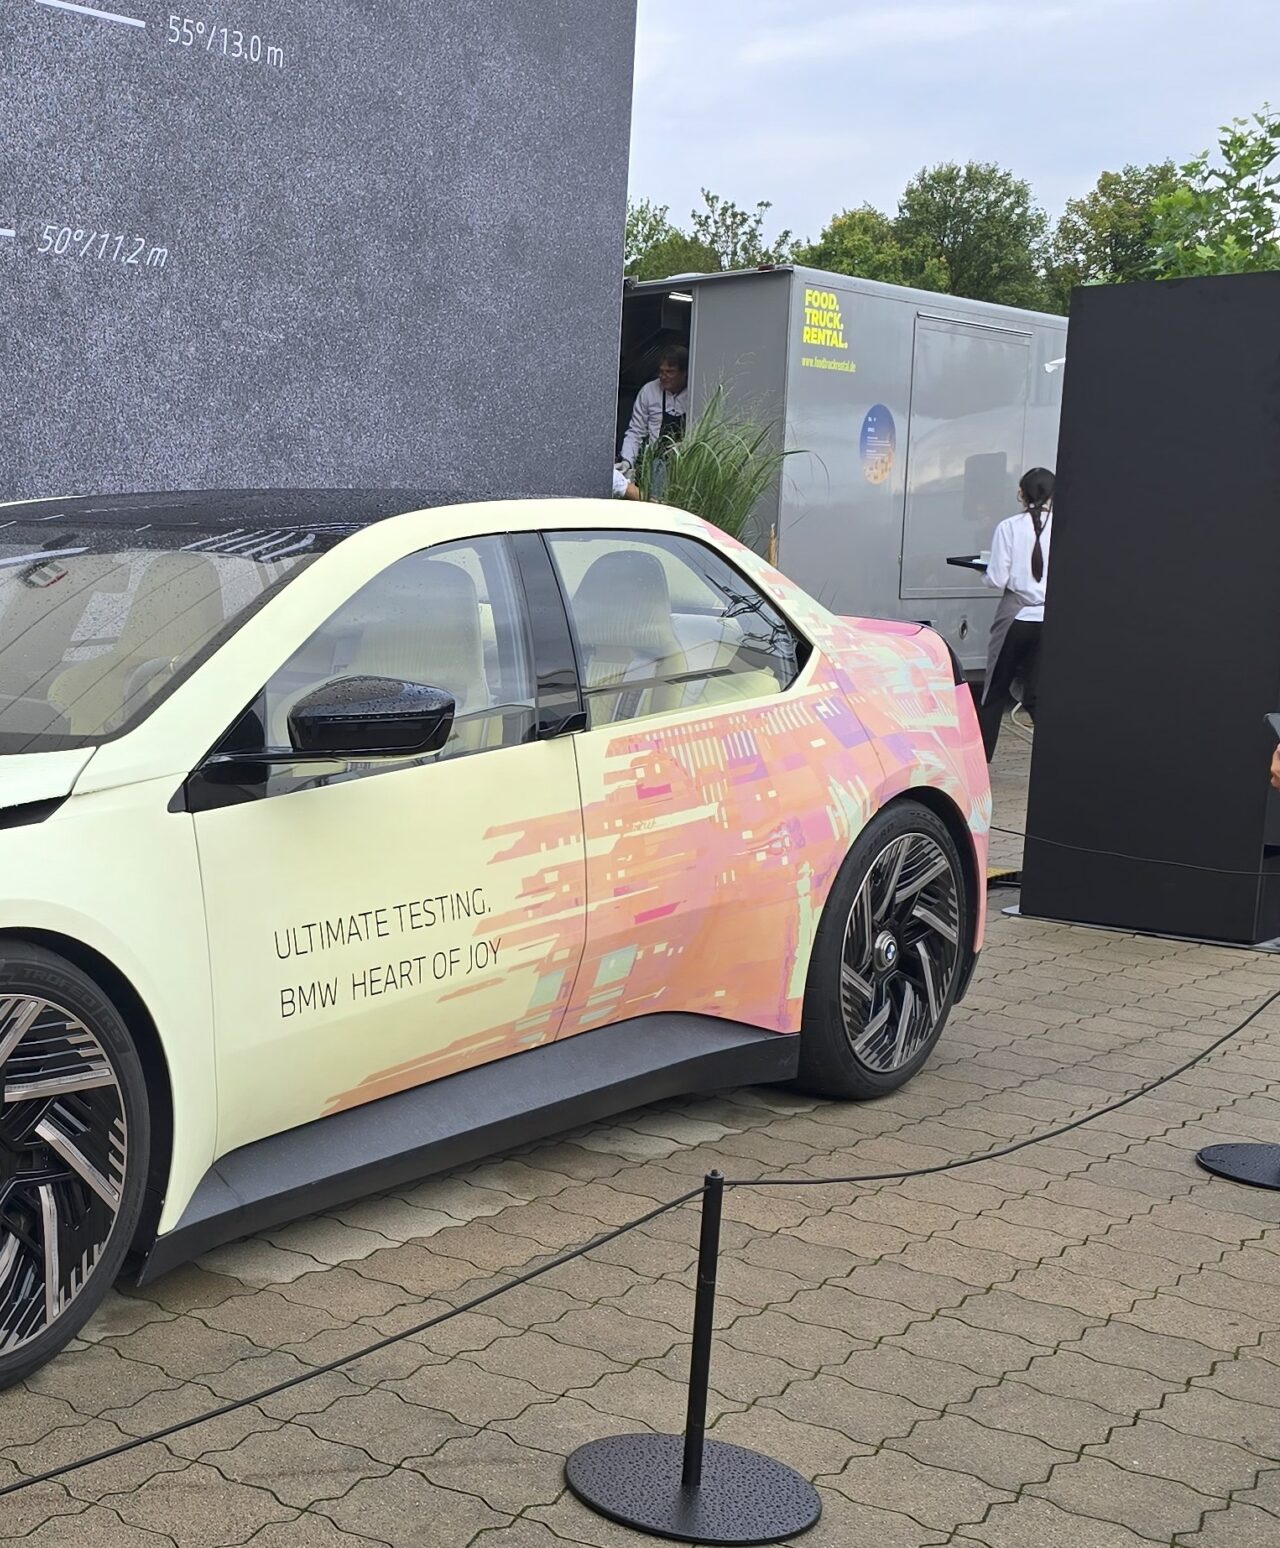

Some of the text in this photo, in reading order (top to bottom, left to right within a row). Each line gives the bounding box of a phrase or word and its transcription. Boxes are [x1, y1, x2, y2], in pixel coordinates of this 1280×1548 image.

[266, 45, 285, 68] m
[145, 247, 169, 268] m
[804, 289, 840, 311] FOOD.
[804, 308, 845, 331] TRUCK.
[802, 328, 849, 350] RENTAL.
[274, 887, 492, 960] ULTIMATE TESTING.
[280, 936, 503, 1019] BMW HEART OF JOY
